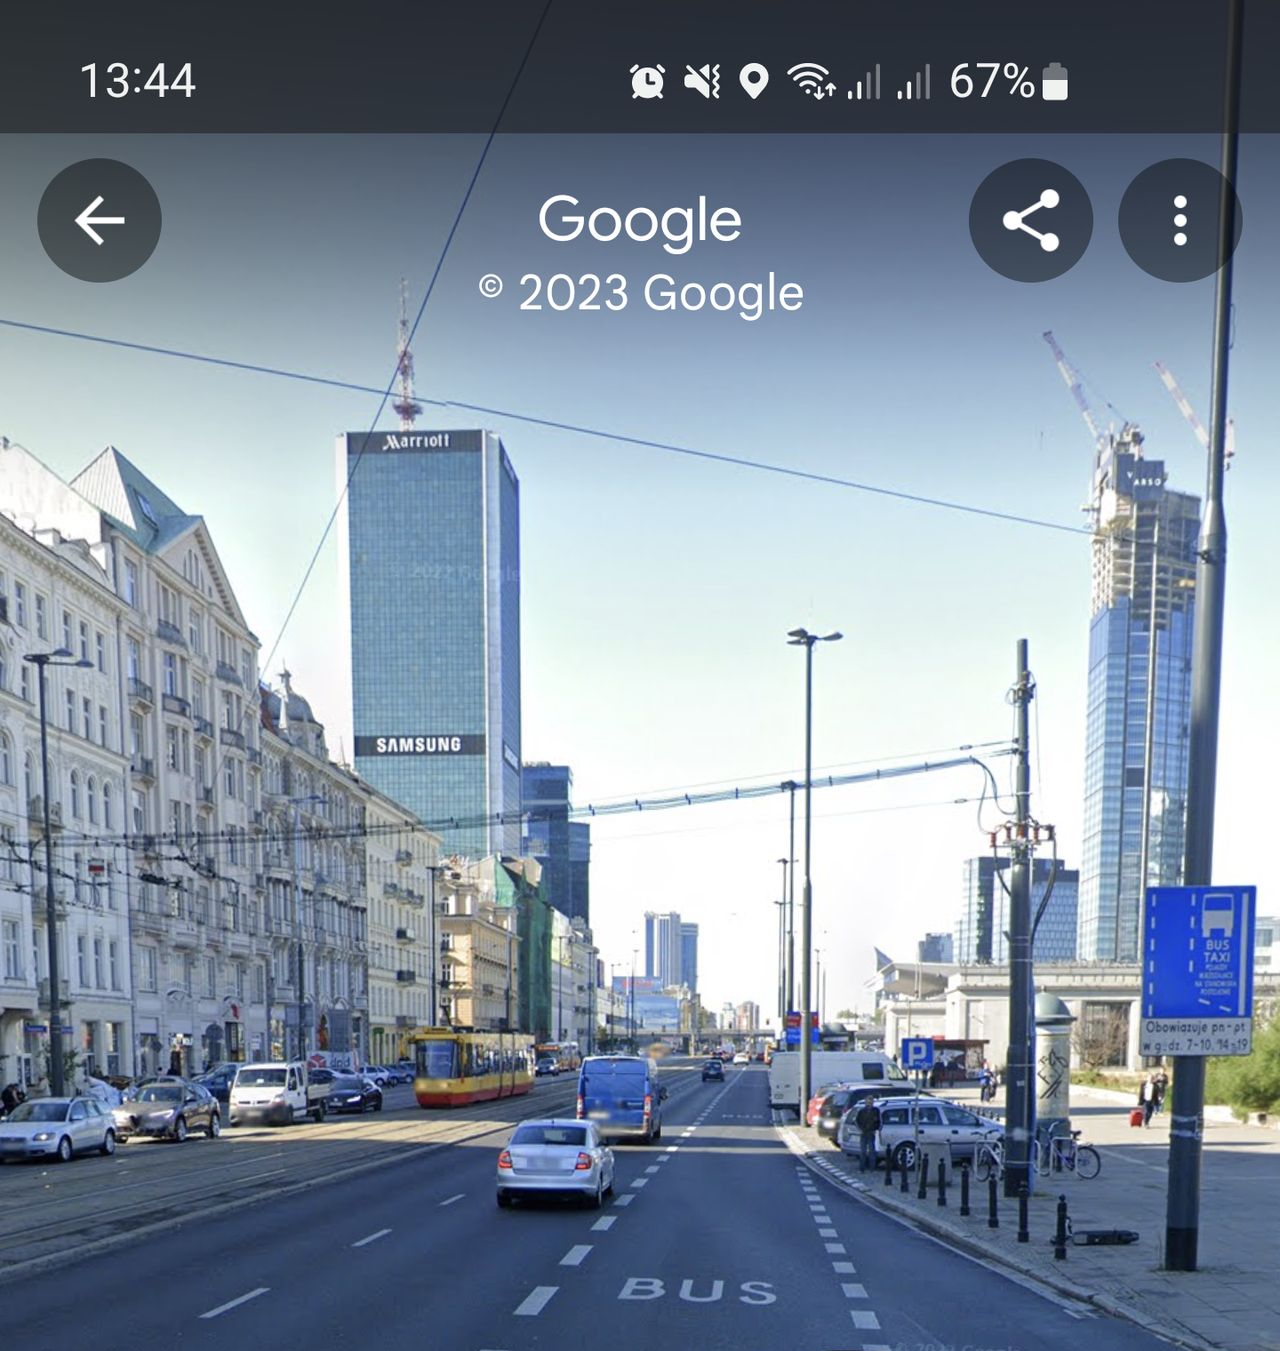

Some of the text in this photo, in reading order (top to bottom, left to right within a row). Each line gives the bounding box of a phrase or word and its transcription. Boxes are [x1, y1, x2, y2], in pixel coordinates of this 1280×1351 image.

[382, 432, 450, 450] Marriott
[376, 736, 461, 753] SAMSUNG
[1206, 939, 1230, 951] BUS
[1203, 951, 1231, 963] TAXI
[908, 1041, 927, 1066] P
[1143, 1043, 1151, 1051] w
[617, 1277, 777, 1305] BUS
